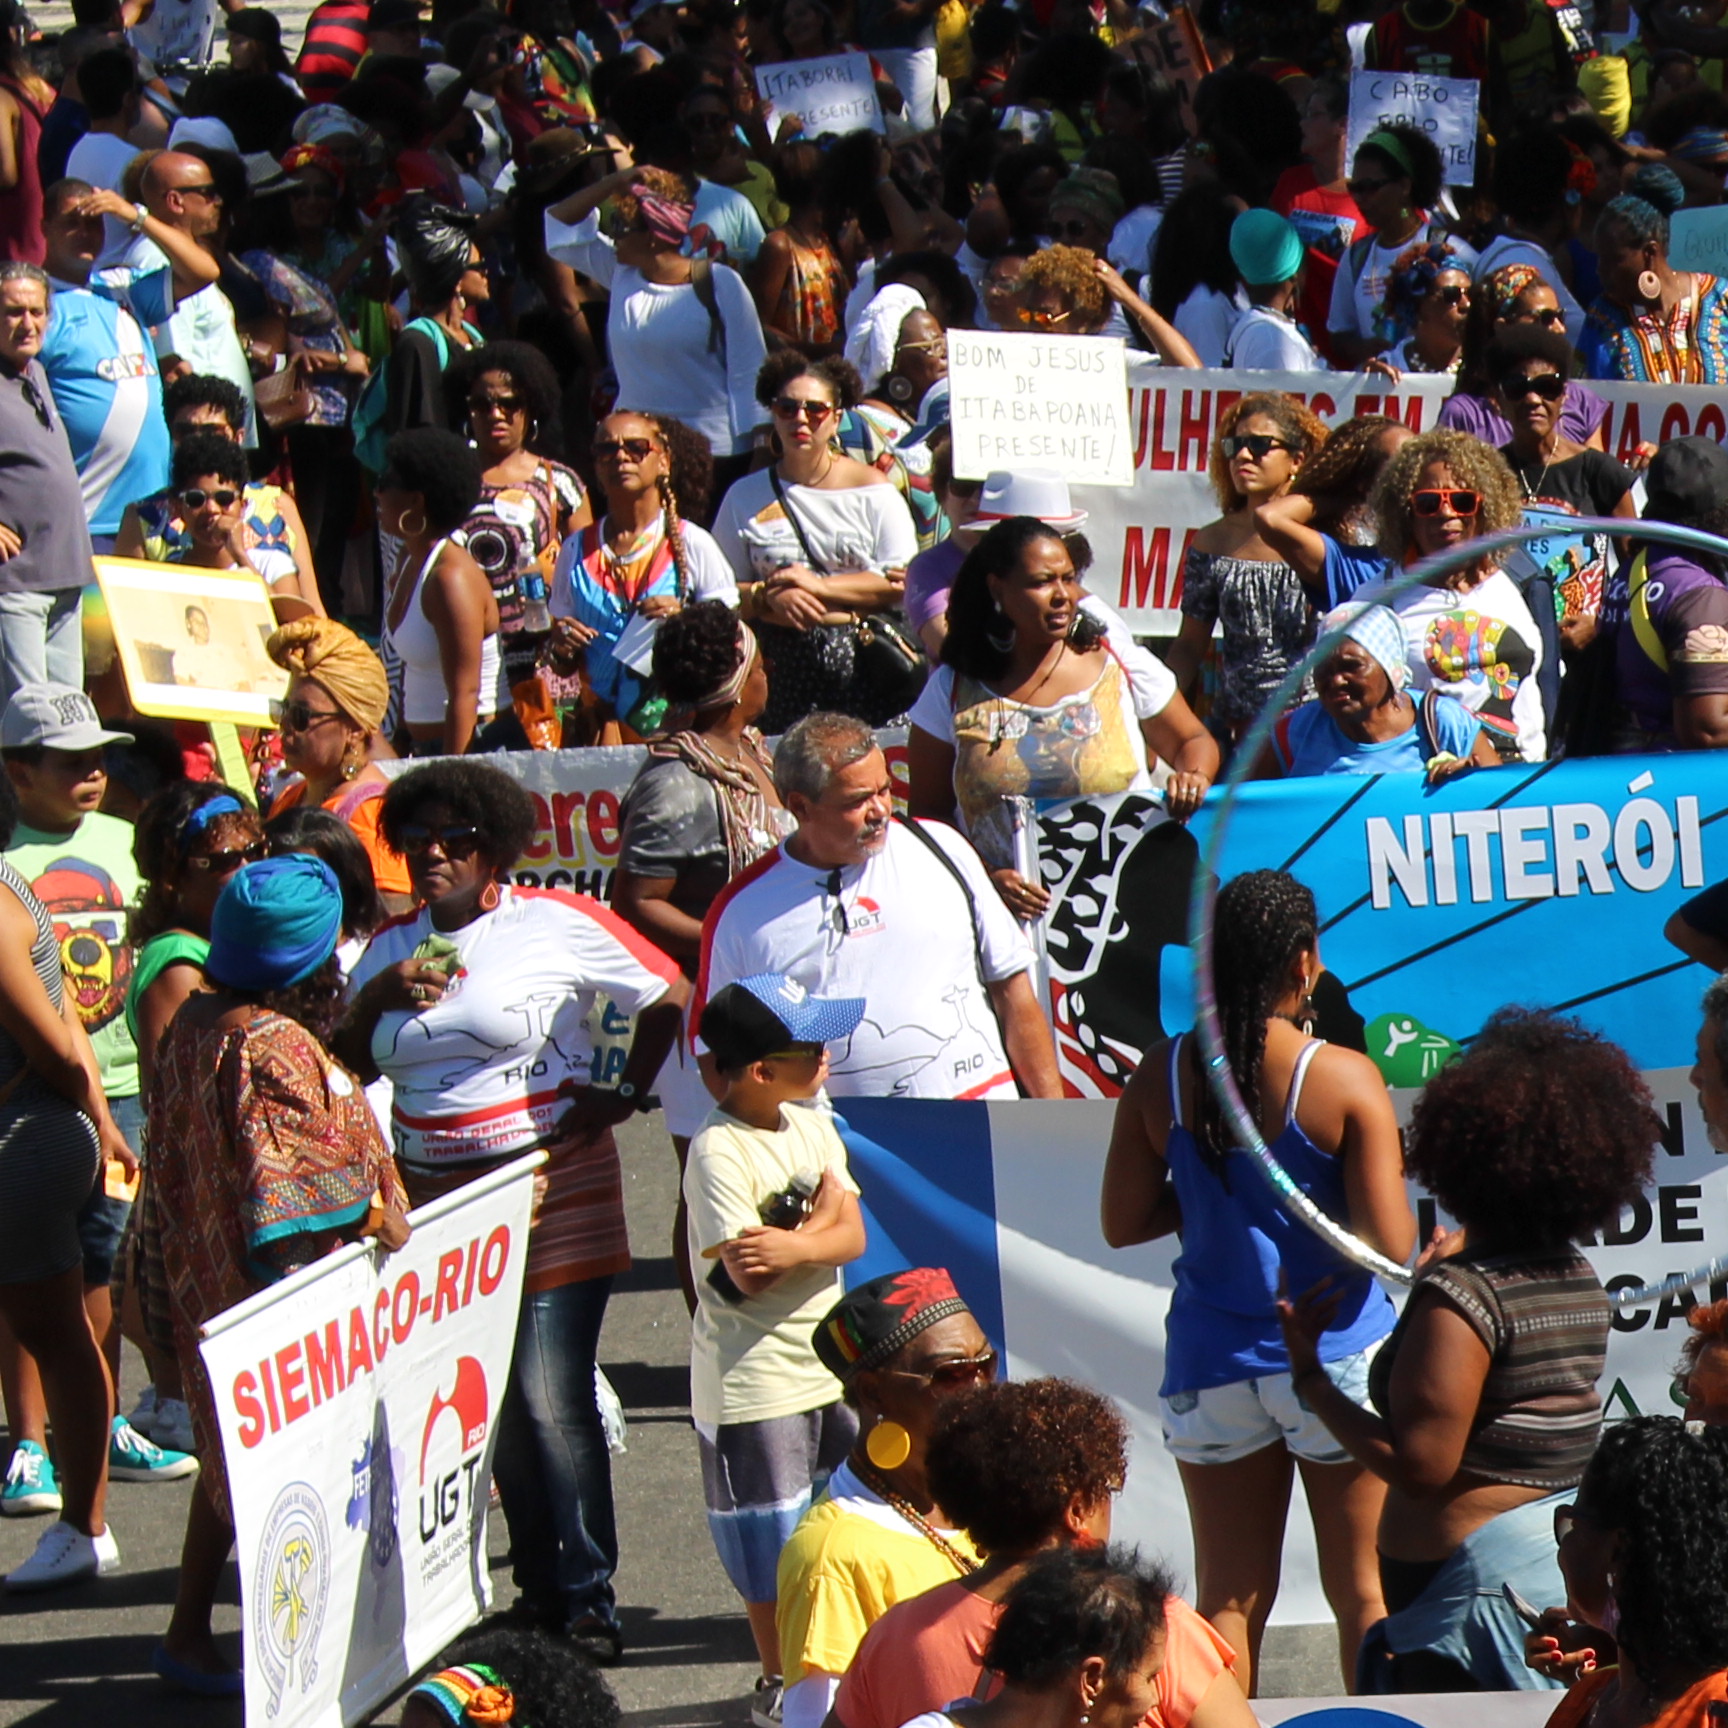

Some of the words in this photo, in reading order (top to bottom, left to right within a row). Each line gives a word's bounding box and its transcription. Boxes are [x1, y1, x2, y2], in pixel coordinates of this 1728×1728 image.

[1370, 80, 1449, 102] CABO
[797, 95, 878, 126] RESENTE!
[955, 343, 1006, 370] BOM
[1030, 345, 1106, 373] JESUS
[1015, 375, 1036, 394] DE
[960, 397, 1118, 429] ITABAPOANA
[978, 433, 1116, 476] PRESENTE!
[1367, 772, 1705, 909] NITERÓI
[504, 1060, 548, 1085] RIO
[954, 1053, 985, 1079] RIO
[232, 1222, 510, 1451] SIEMACO-RIO
[466, 1421, 486, 1451] RIO
[413, 1451, 484, 1545] UGT
